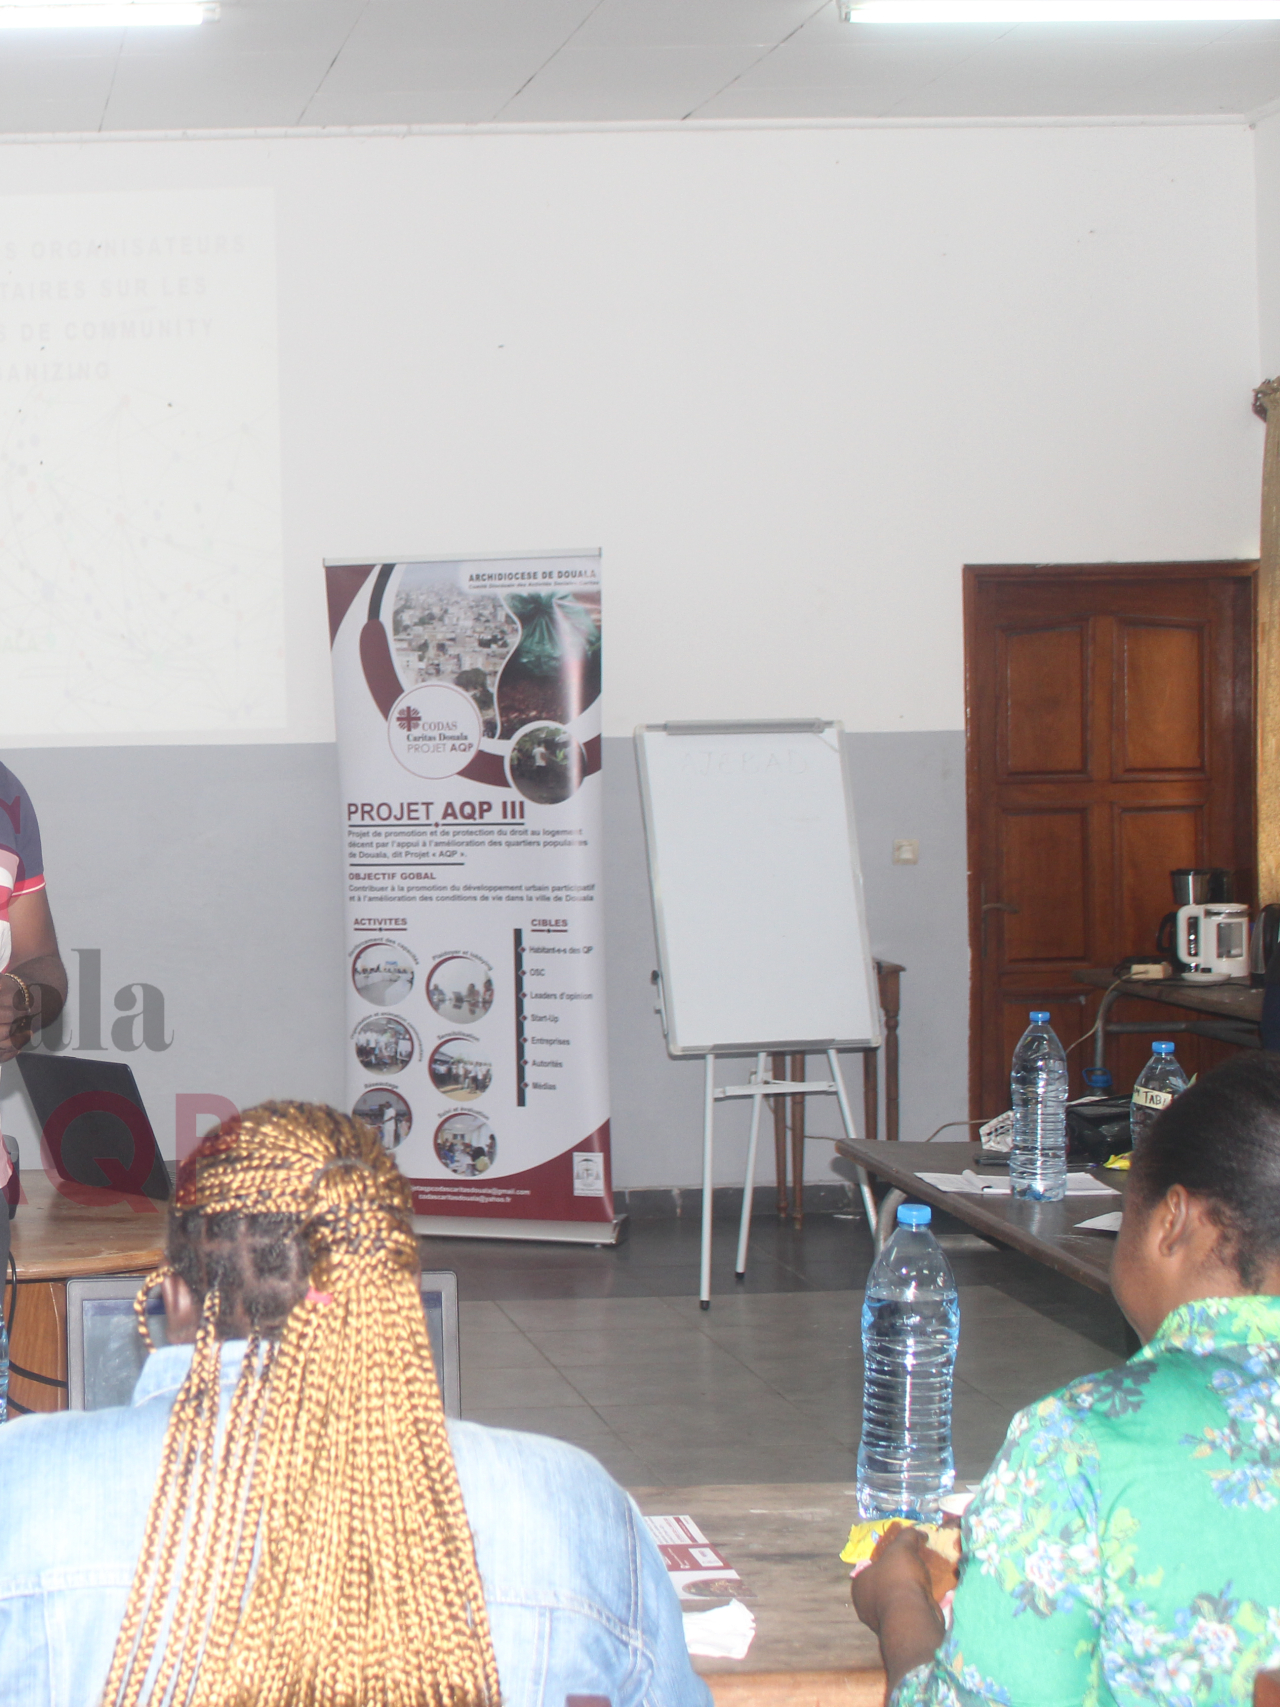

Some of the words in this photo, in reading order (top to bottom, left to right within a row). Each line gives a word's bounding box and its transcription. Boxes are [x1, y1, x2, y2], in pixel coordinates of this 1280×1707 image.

[31, 234, 246, 260] ORGANISATEURS
[100, 278, 149, 298] SUR
[161, 276, 207, 296] LES
[20, 323, 51, 343] DE
[64, 318, 214, 341] COMMUNITY
[541, 571, 554, 579] DE
[558, 570, 597, 579] DOUALA
[422, 721, 457, 731] CODAS
[407, 733, 436, 742] Caritas
[439, 732, 468, 741] Douala
[407, 743, 446, 753] PROJET
[450, 743, 473, 752] AQP
[347, 802, 434, 821] PROJET
[441, 801, 492, 821] AQP
[502, 801, 524, 819] III
[348, 830, 370, 839] Projet
[384, 829, 427, 838] promotion
[452, 829, 494, 837] protection
[376, 841, 389, 849] par
[505, 840, 540, 848] quartiers
[543, 840, 588, 848] populaes
[405, 850, 430, 859] Projet
[400, 872, 436, 880] GOBAL
[530, 968, 545, 976] OSC
[531, 1036, 570, 1046] Entreprises
